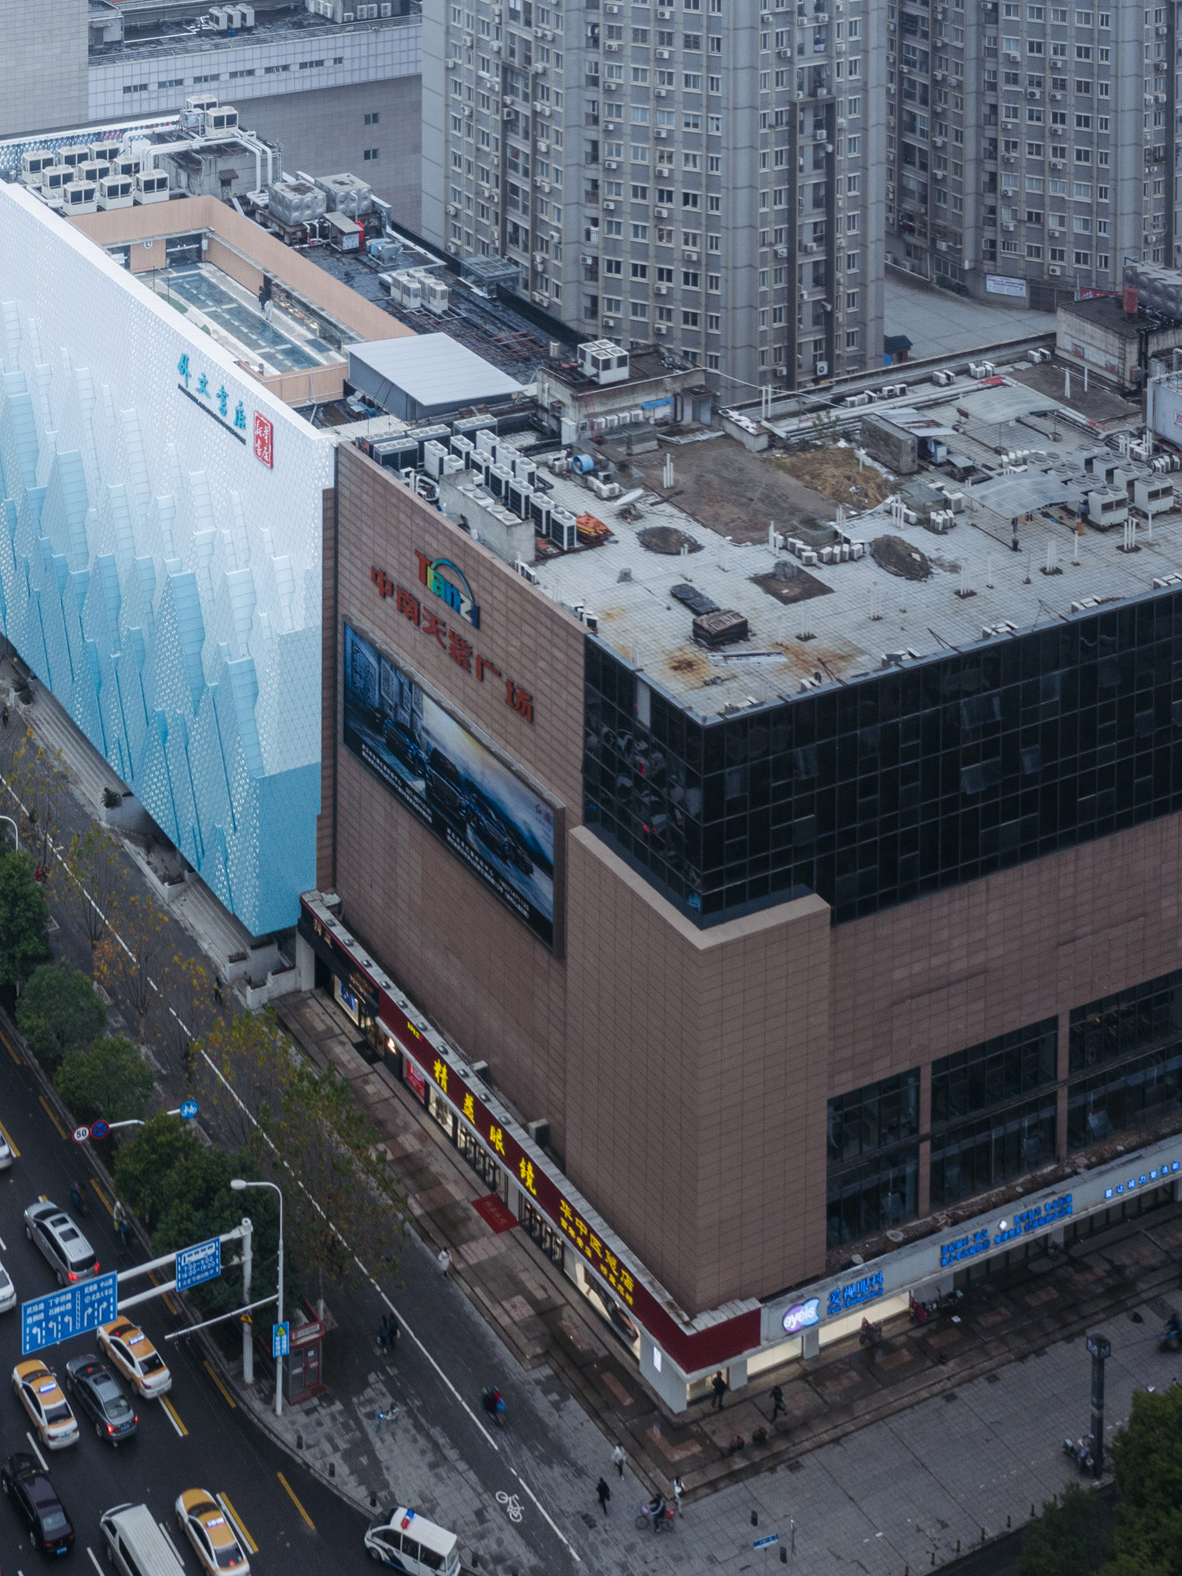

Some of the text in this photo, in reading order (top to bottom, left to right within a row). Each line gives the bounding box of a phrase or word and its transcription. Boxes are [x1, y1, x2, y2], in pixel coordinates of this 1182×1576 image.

[371, 566, 534, 724] 中南天紫广场
[76, 1129, 87, 1139] 50
[433, 1059, 537, 1196] 精益眼镜
